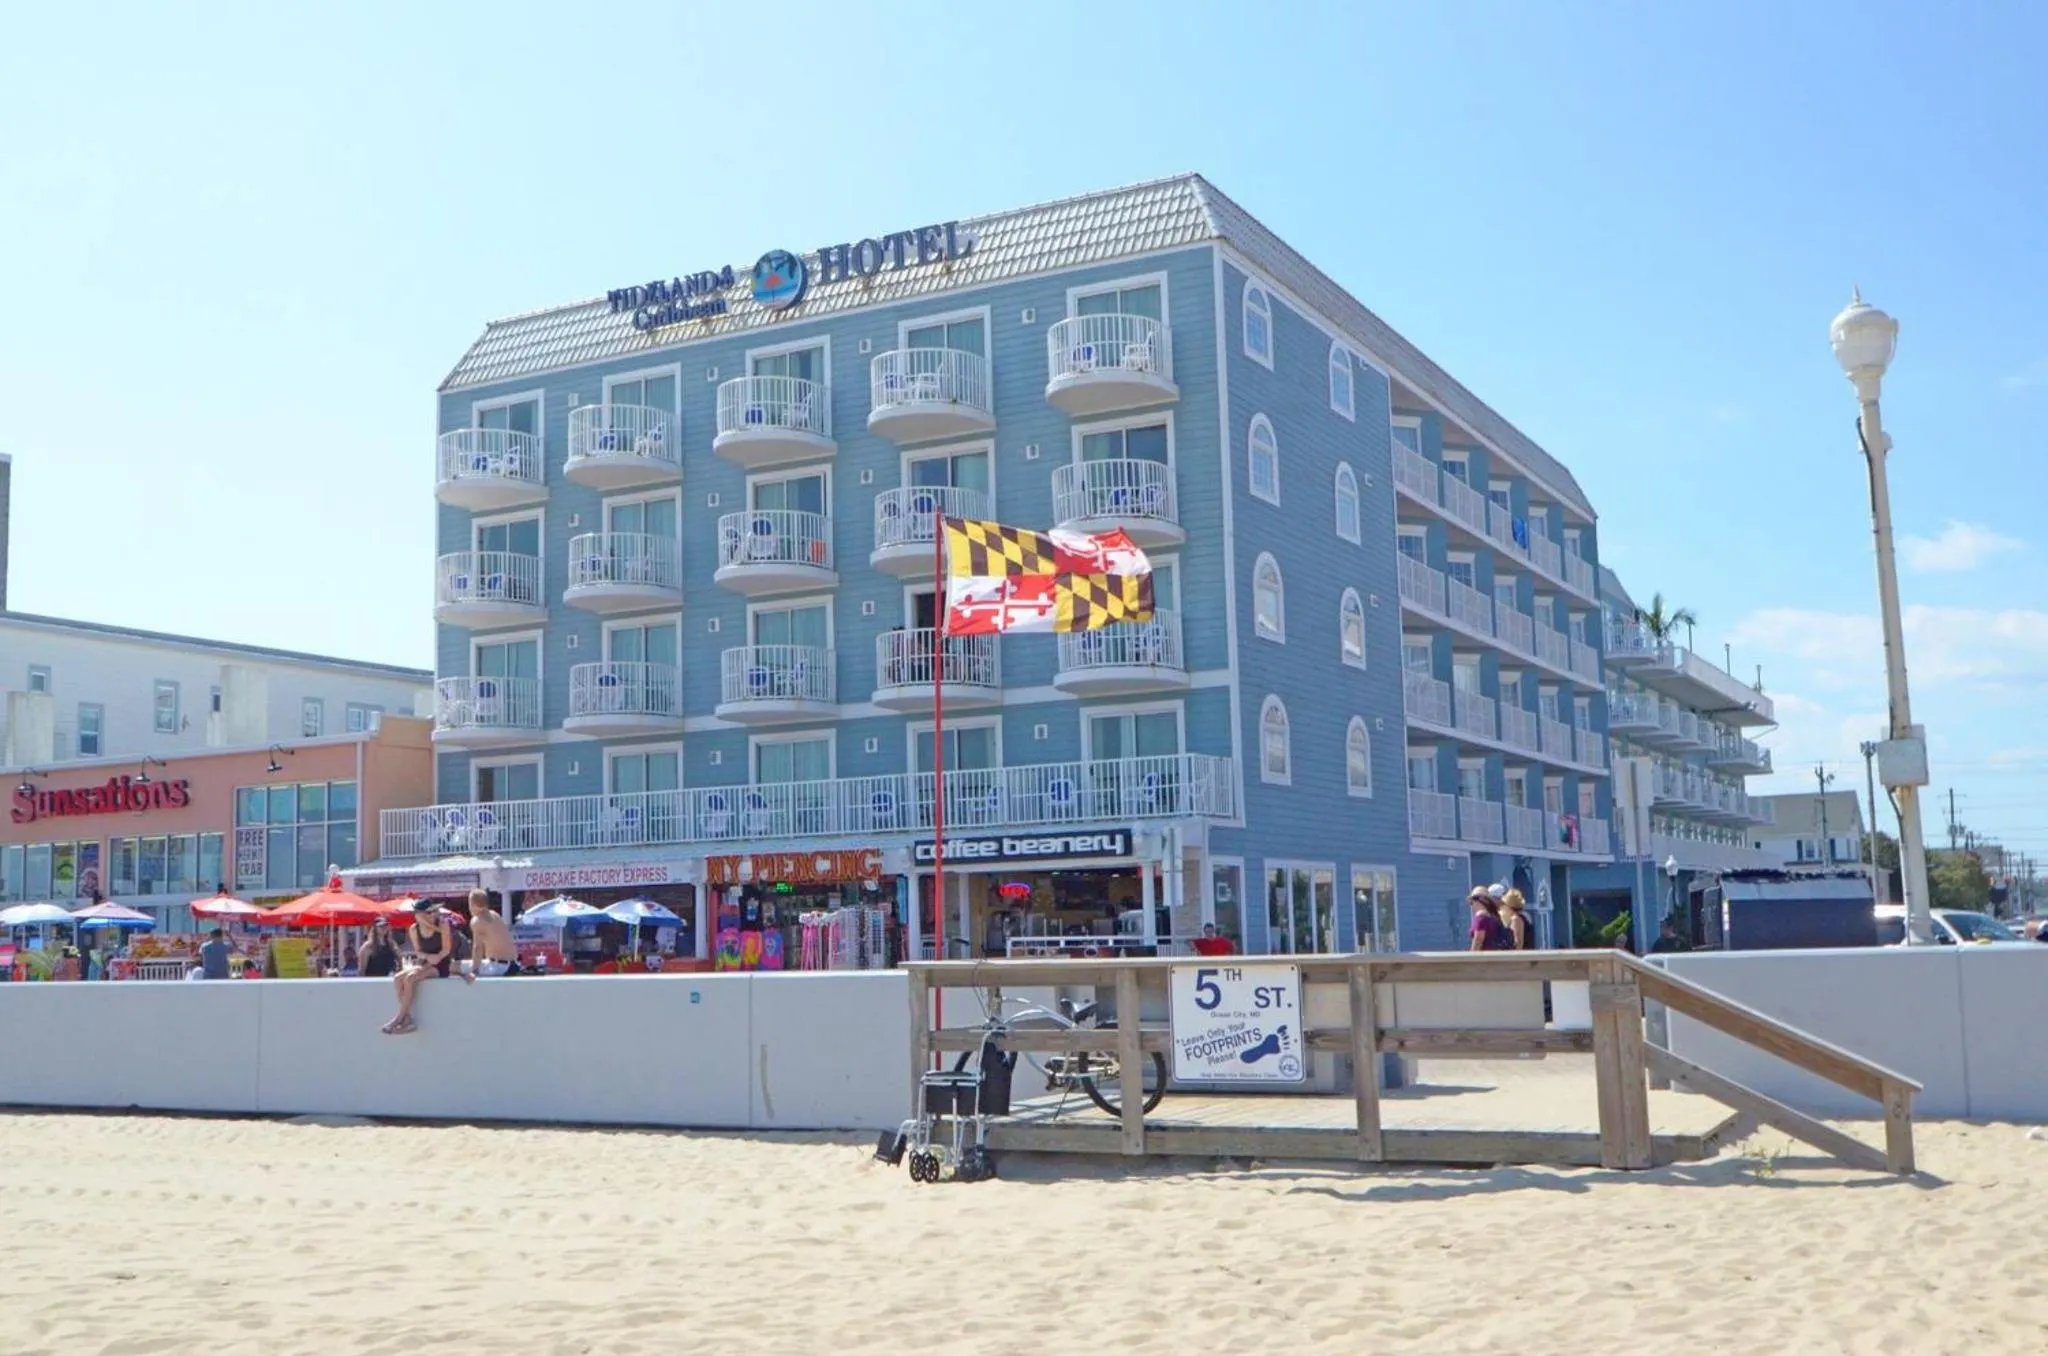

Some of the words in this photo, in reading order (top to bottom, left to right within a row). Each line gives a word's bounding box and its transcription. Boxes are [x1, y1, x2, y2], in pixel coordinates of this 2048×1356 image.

[817, 220, 973, 284] HOTEL
[11, 774, 191, 823] Sunsations
[239, 831, 263, 846] FREE
[1003, 834, 1124, 856] beanery
[525, 870, 577, 887] CRABCAKE
[578, 867, 622, 885] FACTORY
[623, 866, 668, 883] EXPRESS
[706, 855, 744, 884] NY
[751, 848, 884, 883] PIERCING
[1194, 969, 1222, 1010] 5
[1223, 968, 1242, 981] TH
[1254, 987, 1292, 1008] ST.
[1181, 1033, 1205, 1047] Leave
[1207, 1027, 1226, 1040] Only
[1228, 1021, 1246, 1034] Your
[1184, 1028, 1263, 1061] FOOTPRINTS
[1207, 1051, 1236, 1066] Please!
